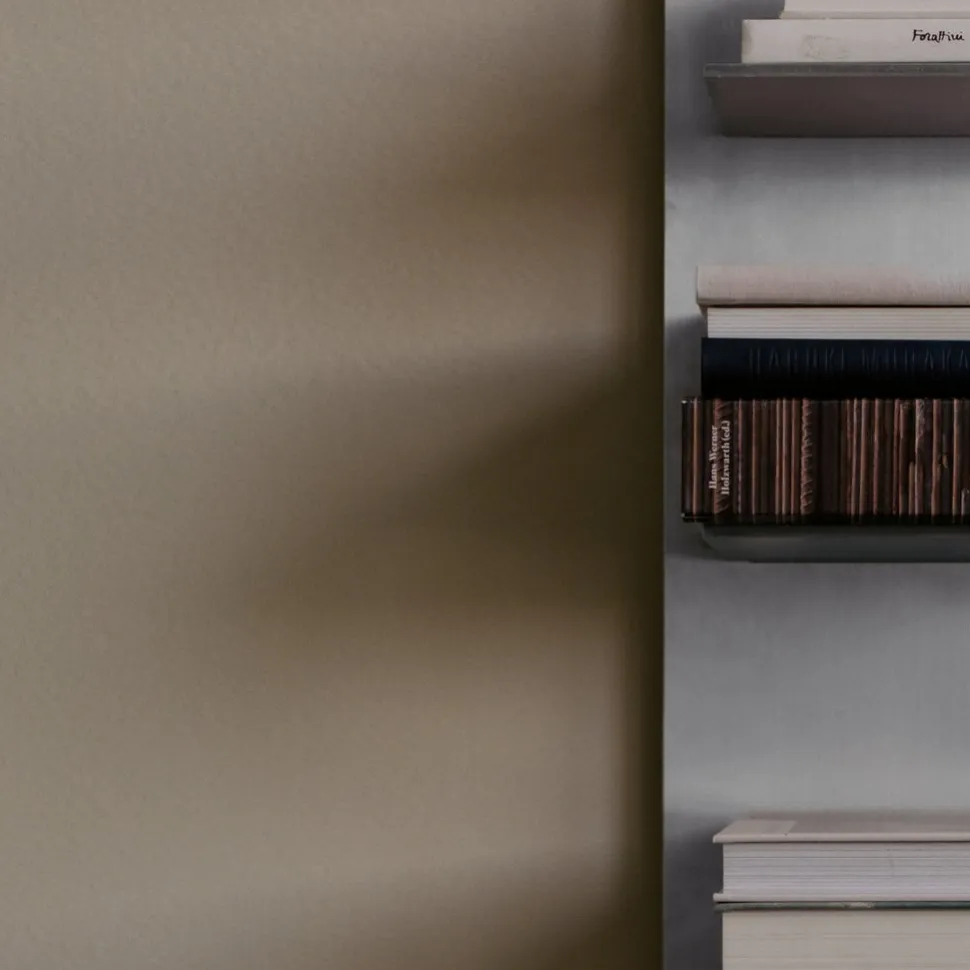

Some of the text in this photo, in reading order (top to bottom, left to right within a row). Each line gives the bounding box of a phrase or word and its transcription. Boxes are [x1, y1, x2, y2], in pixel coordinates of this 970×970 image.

[708, 424, 718, 490] Hans Werner
[721, 442, 730, 496] Holzwarth
